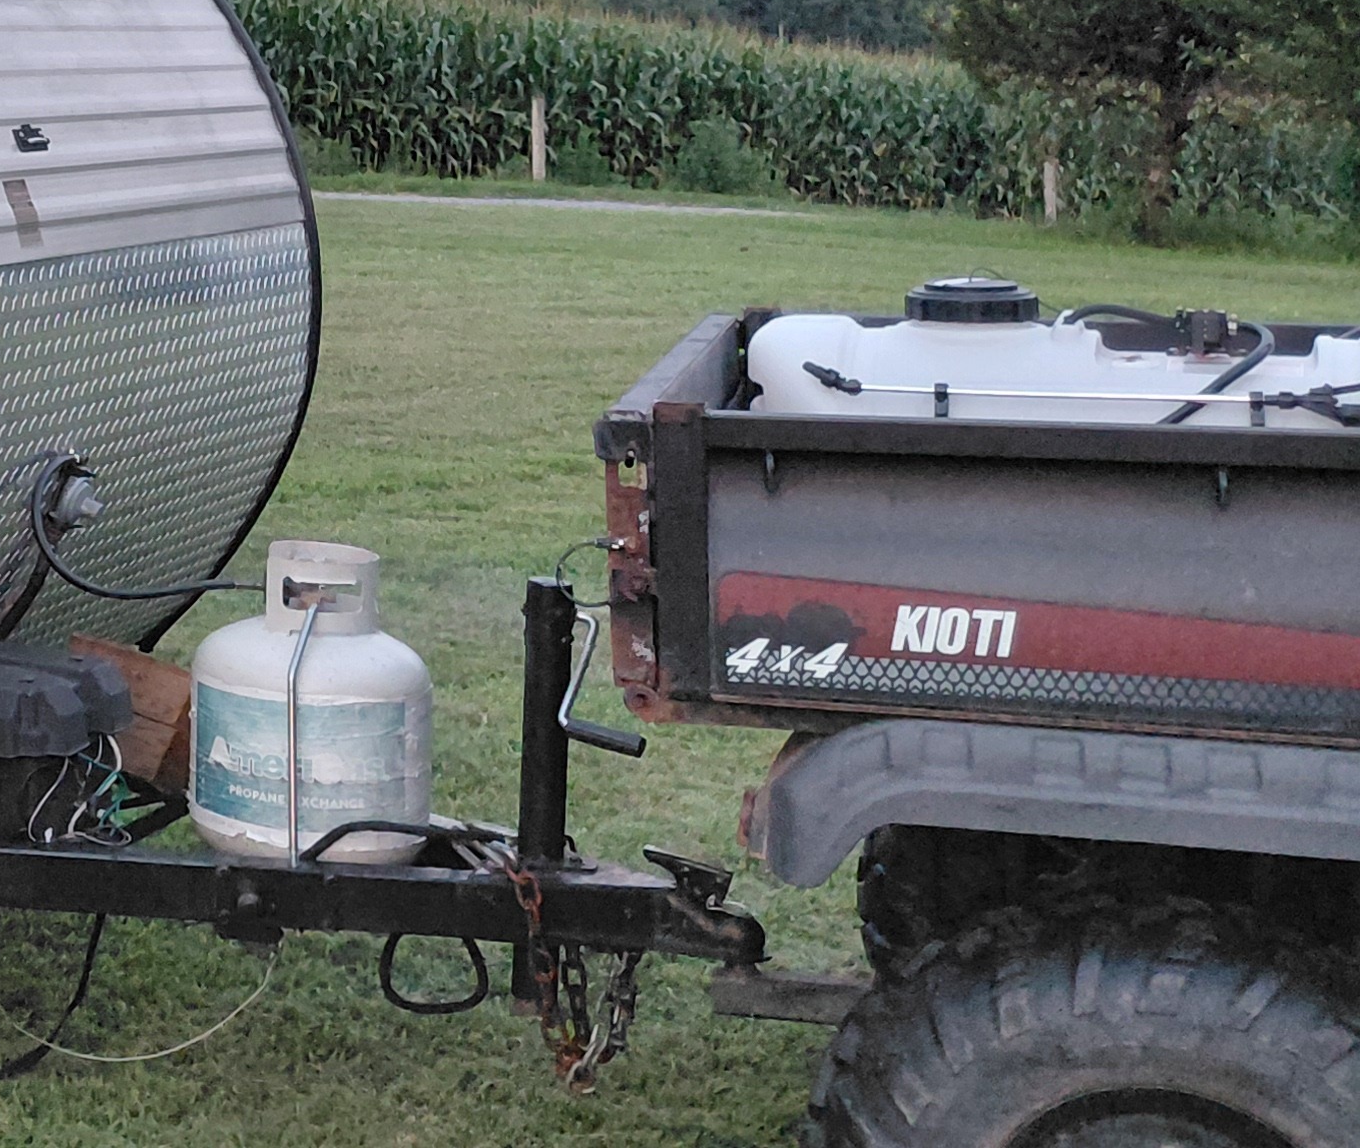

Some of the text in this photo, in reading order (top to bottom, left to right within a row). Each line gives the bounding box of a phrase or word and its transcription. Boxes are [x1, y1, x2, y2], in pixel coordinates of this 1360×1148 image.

[890, 604, 1018, 659] KIOTI
[229, 783, 366, 810] PROPANE XCHANGE
